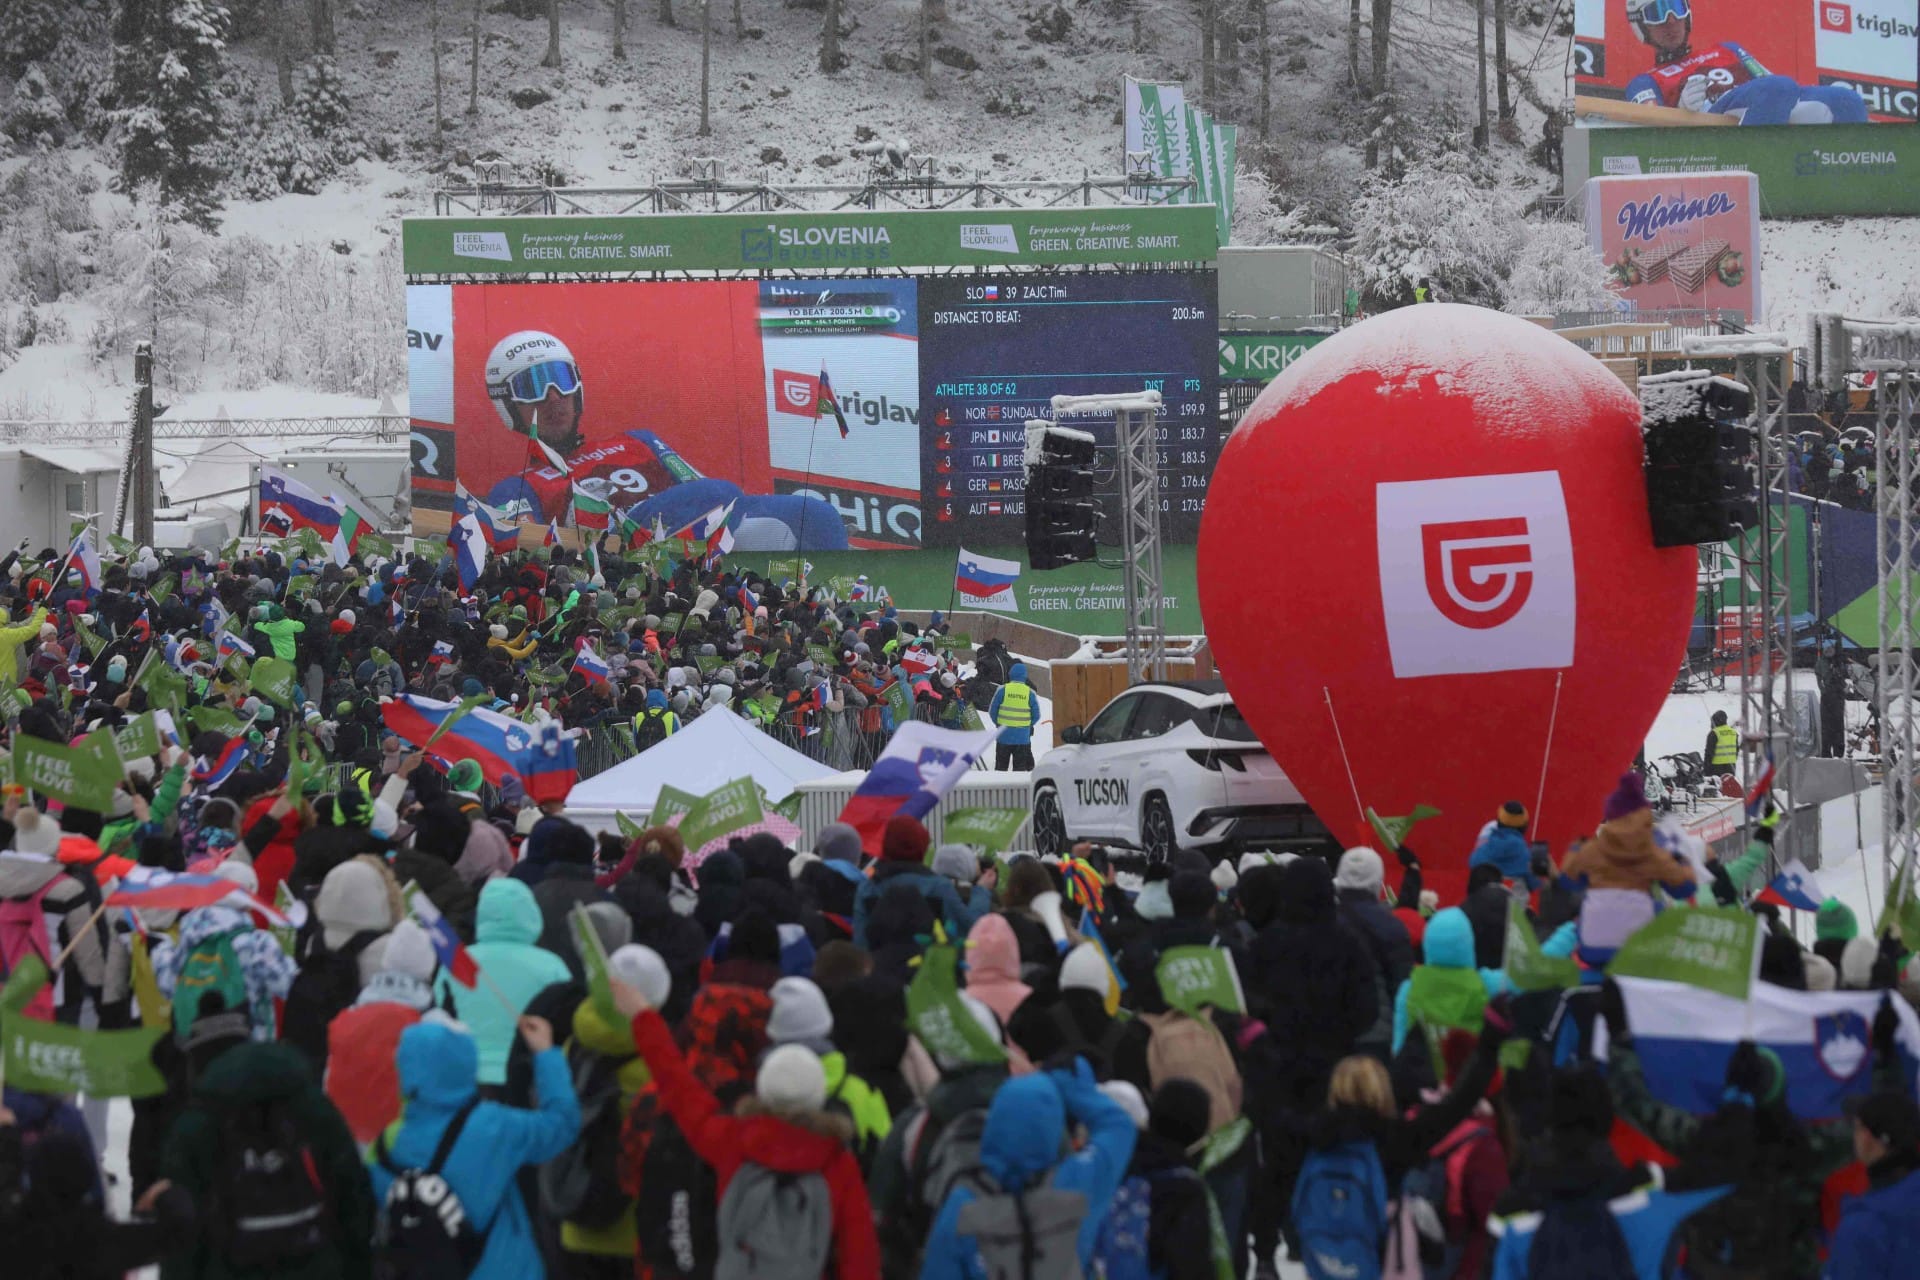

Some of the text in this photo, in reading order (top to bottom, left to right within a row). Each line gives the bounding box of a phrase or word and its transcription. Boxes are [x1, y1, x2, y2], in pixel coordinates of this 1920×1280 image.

[1856, 14, 1918, 37] triglav
[1821, 152, 1897, 164] SLOVENIA
[1617, 192, 1736, 241] Manner
[779, 226, 891, 245] SLOVENIA
[969, 227, 990, 235] FEEL
[1029, 222, 1133, 236] Empowering business
[462, 235, 484, 243] FEEL
[522, 231, 624, 245] Empowering business
[964, 236, 1009, 245] SLOVENIA
[1030, 235, 1180, 252] GREEN. CREATIVE. SMART.
[456, 243, 502, 251] SLOVENIA
[523, 245, 673, 260] GREEN. CREATIVE. SMART.
[780, 247, 890, 261] BUSINESS
[966, 286, 1067, 300] SLO 39 ZAJC Timi
[788, 308, 800, 316] TO
[934, 310, 1021, 324] DISTANCE TO BEAT:
[1172, 307, 1205, 320] 200.5m
[505, 339, 556, 361] gorenje
[935, 383, 1016, 396] ATHLETE 38 OF 62
[1145, 380, 1201, 392] DIST PTS
[835, 391, 919, 425] riglav
[945, 408, 951, 420] 1
[966, 407, 986, 419] NOR
[1002, 406, 1038, 419] SUNDAL
[1180, 404, 1205, 416] 199.9
[945, 431, 951, 444] 2
[970, 431, 987, 444] JPN
[1181, 427, 1205, 440] 183.7
[945, 455, 951, 468] 3
[972, 455, 987, 468] ITA
[1182, 451, 1206, 464] 183.5
[945, 480, 951, 491] 4
[968, 478, 987, 491] GER
[1182, 475, 1206, 488] 176.6
[946, 503, 952, 515] 5
[969, 502, 987, 515] AUT
[1029, 582, 1126, 596] Empowering busines
[1030, 598, 1072, 610] GREEN.
[36, 754, 73, 776] FEEL
[1074, 778, 1129, 806] TUCSON
